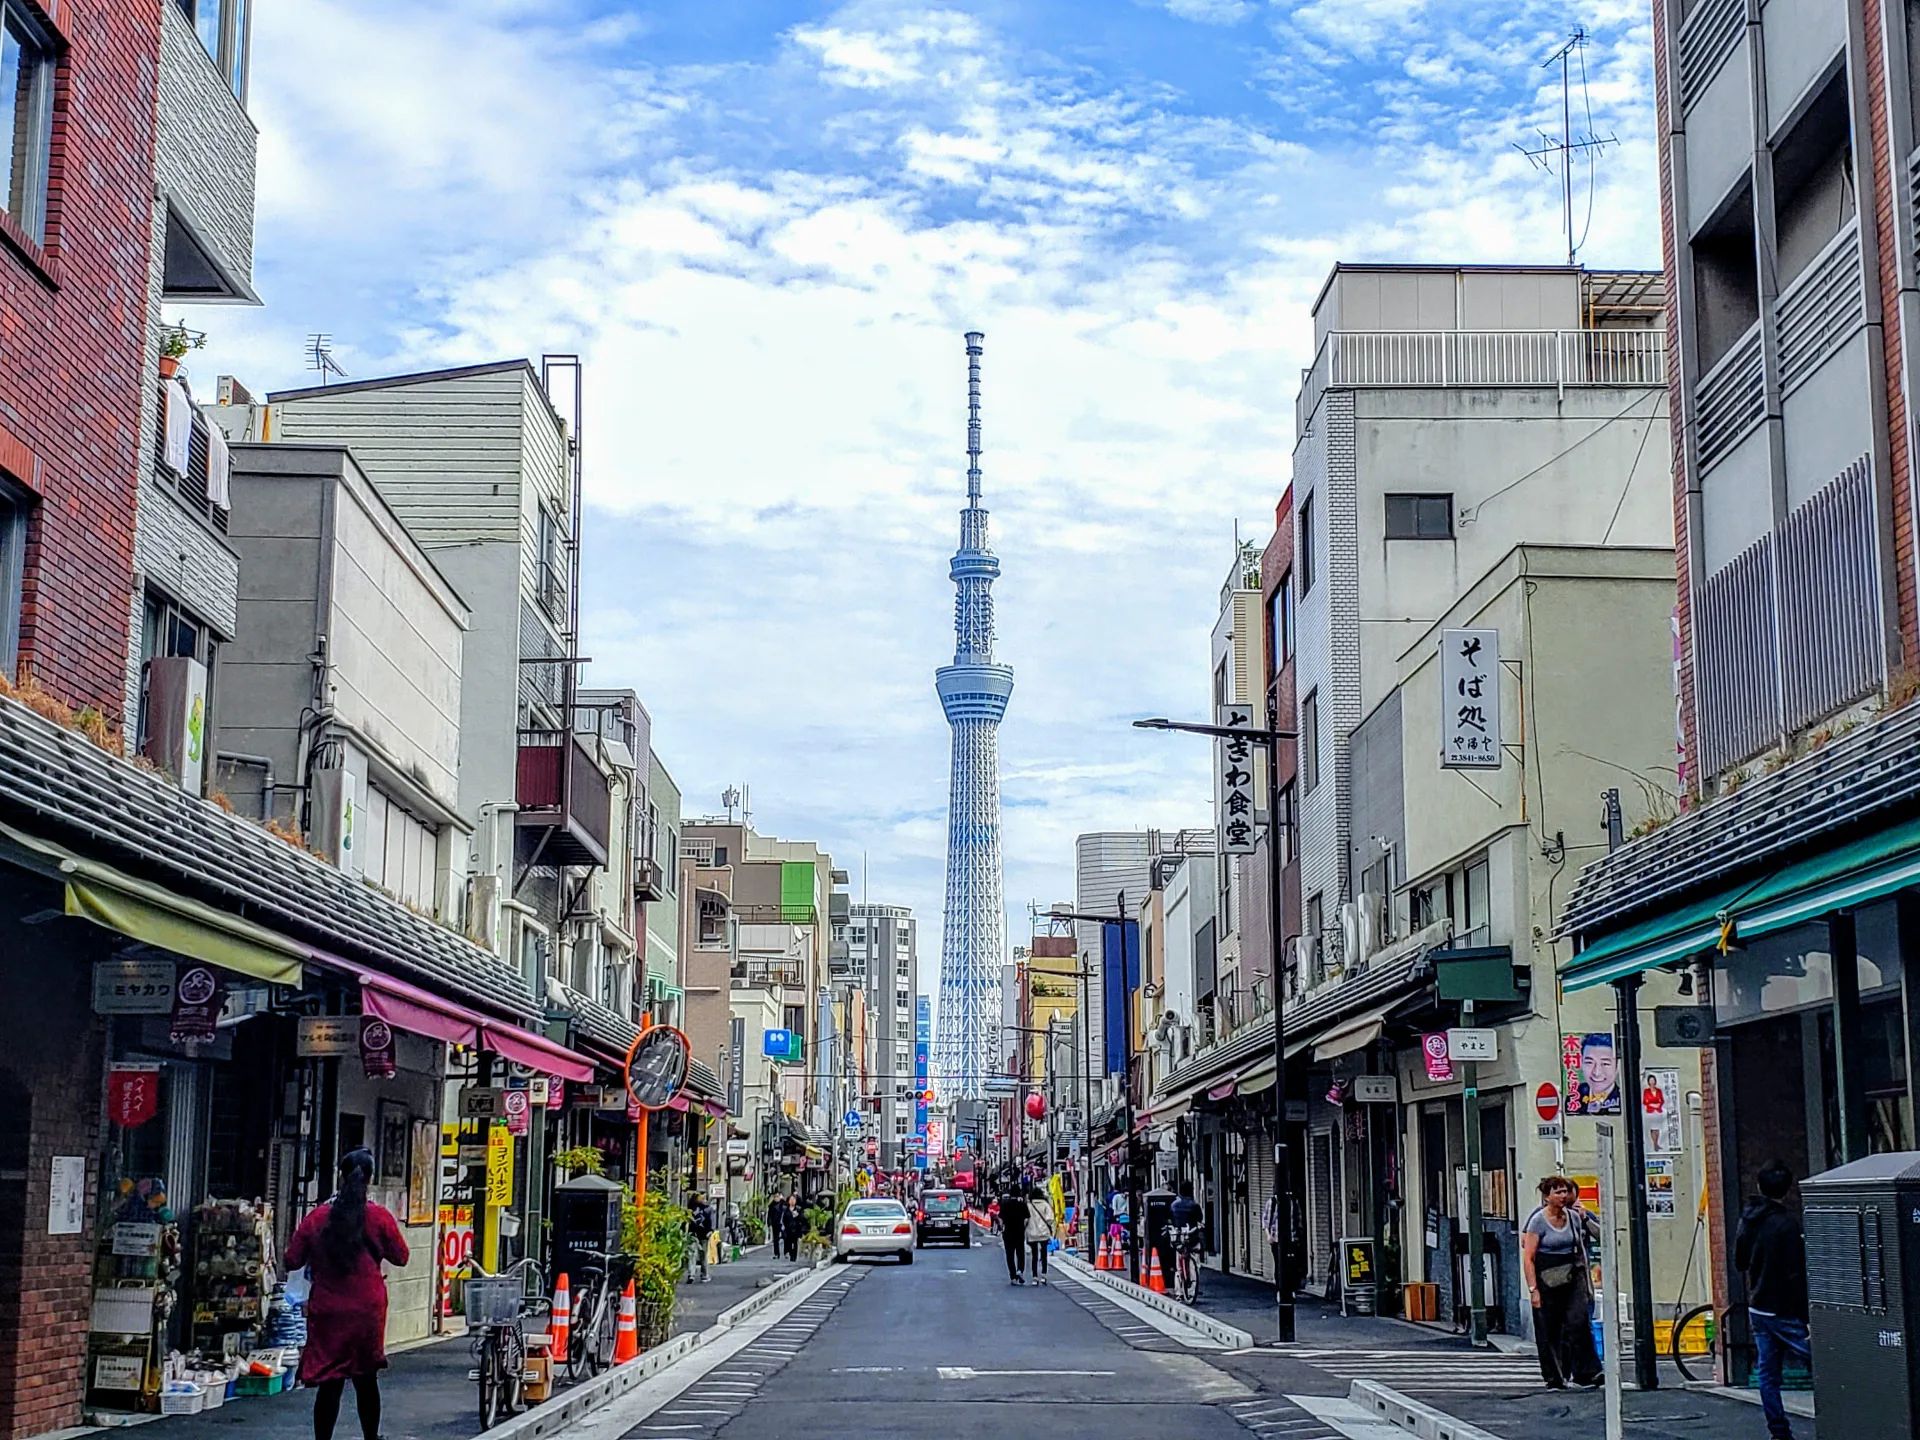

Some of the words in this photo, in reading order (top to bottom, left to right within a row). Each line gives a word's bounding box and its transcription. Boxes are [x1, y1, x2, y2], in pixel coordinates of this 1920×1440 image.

[1458, 637, 1488, 732] そば処
[1224, 711, 1252, 846] ときわ食堂
[115, 984, 170, 996] ミヤカワ
[1461, 1042, 1486, 1050] やまと
[1562, 1034, 1582, 1112] 木村たけつか
[495, 1147, 508, 1201] コインパーキング
